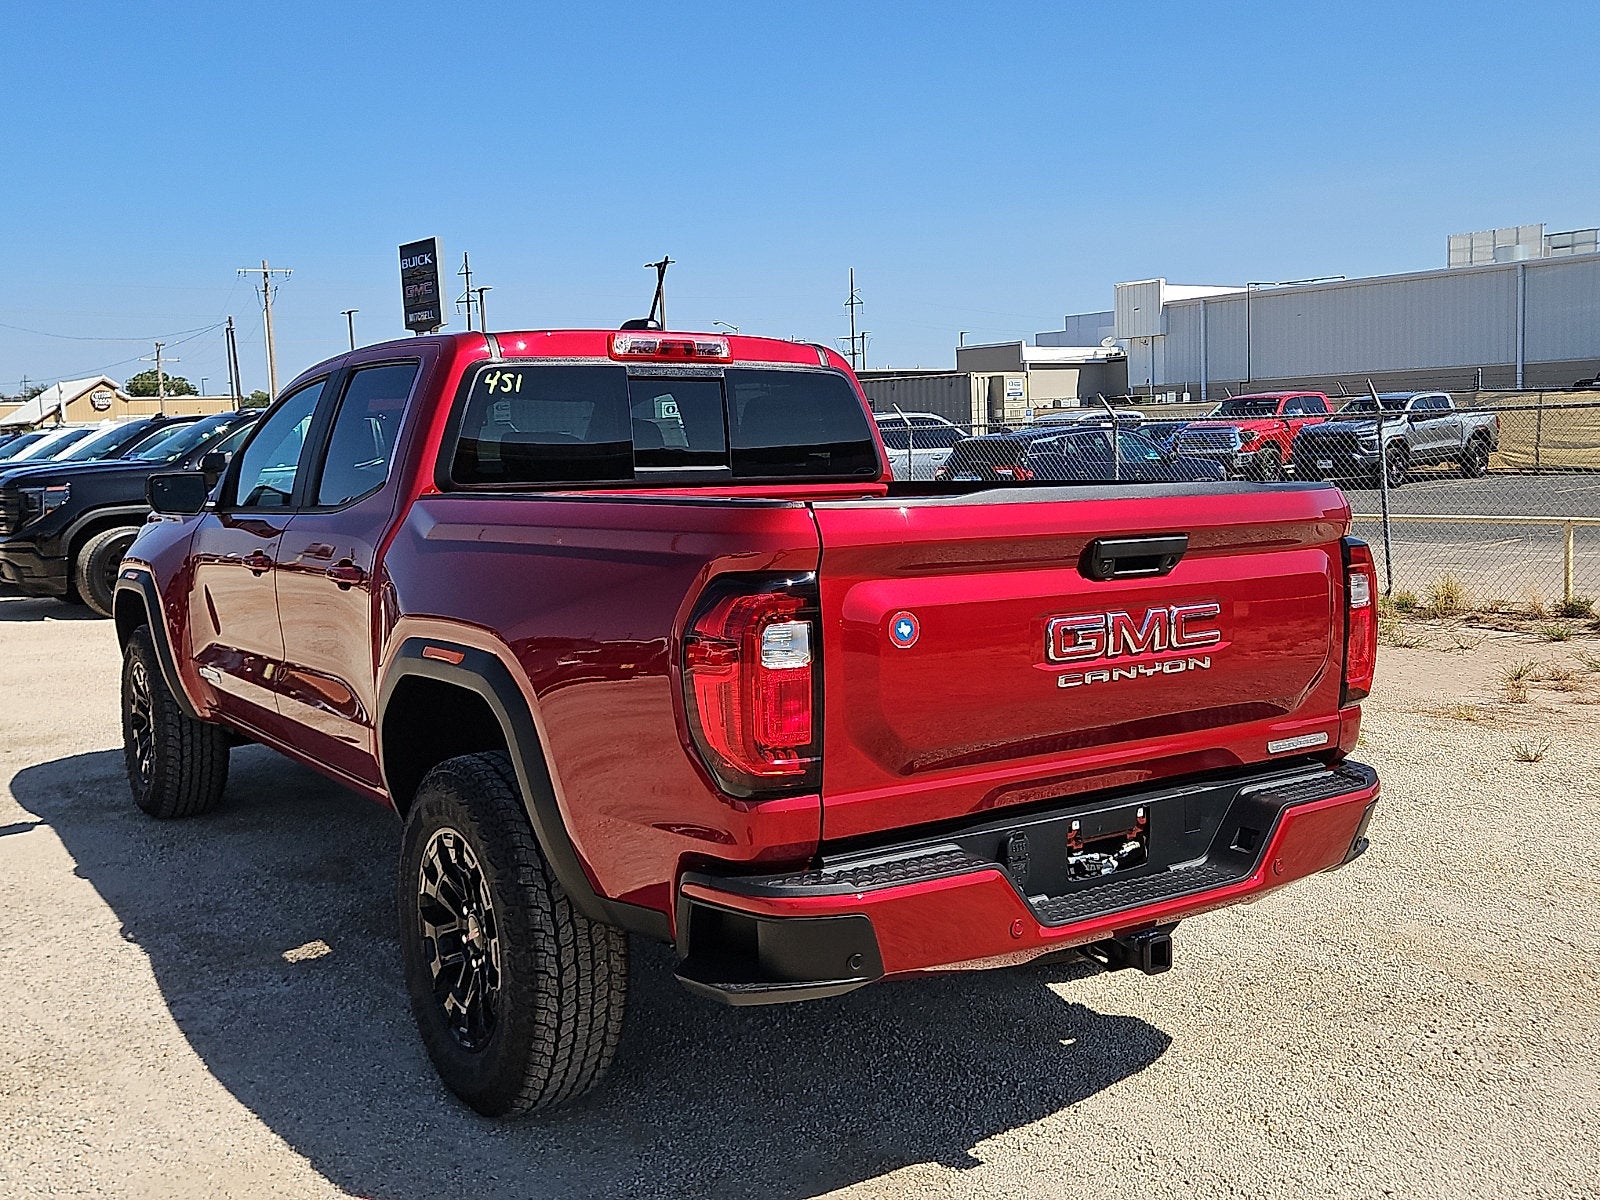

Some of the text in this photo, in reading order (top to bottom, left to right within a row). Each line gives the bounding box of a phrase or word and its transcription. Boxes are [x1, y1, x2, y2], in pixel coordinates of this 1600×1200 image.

[401, 252, 433, 270] BUICK
[405, 281, 433, 298] GMC
[484, 370, 523, 395] 451
[1048, 602, 1221, 662] GMC
[1057, 656, 1211, 688] CANYON
